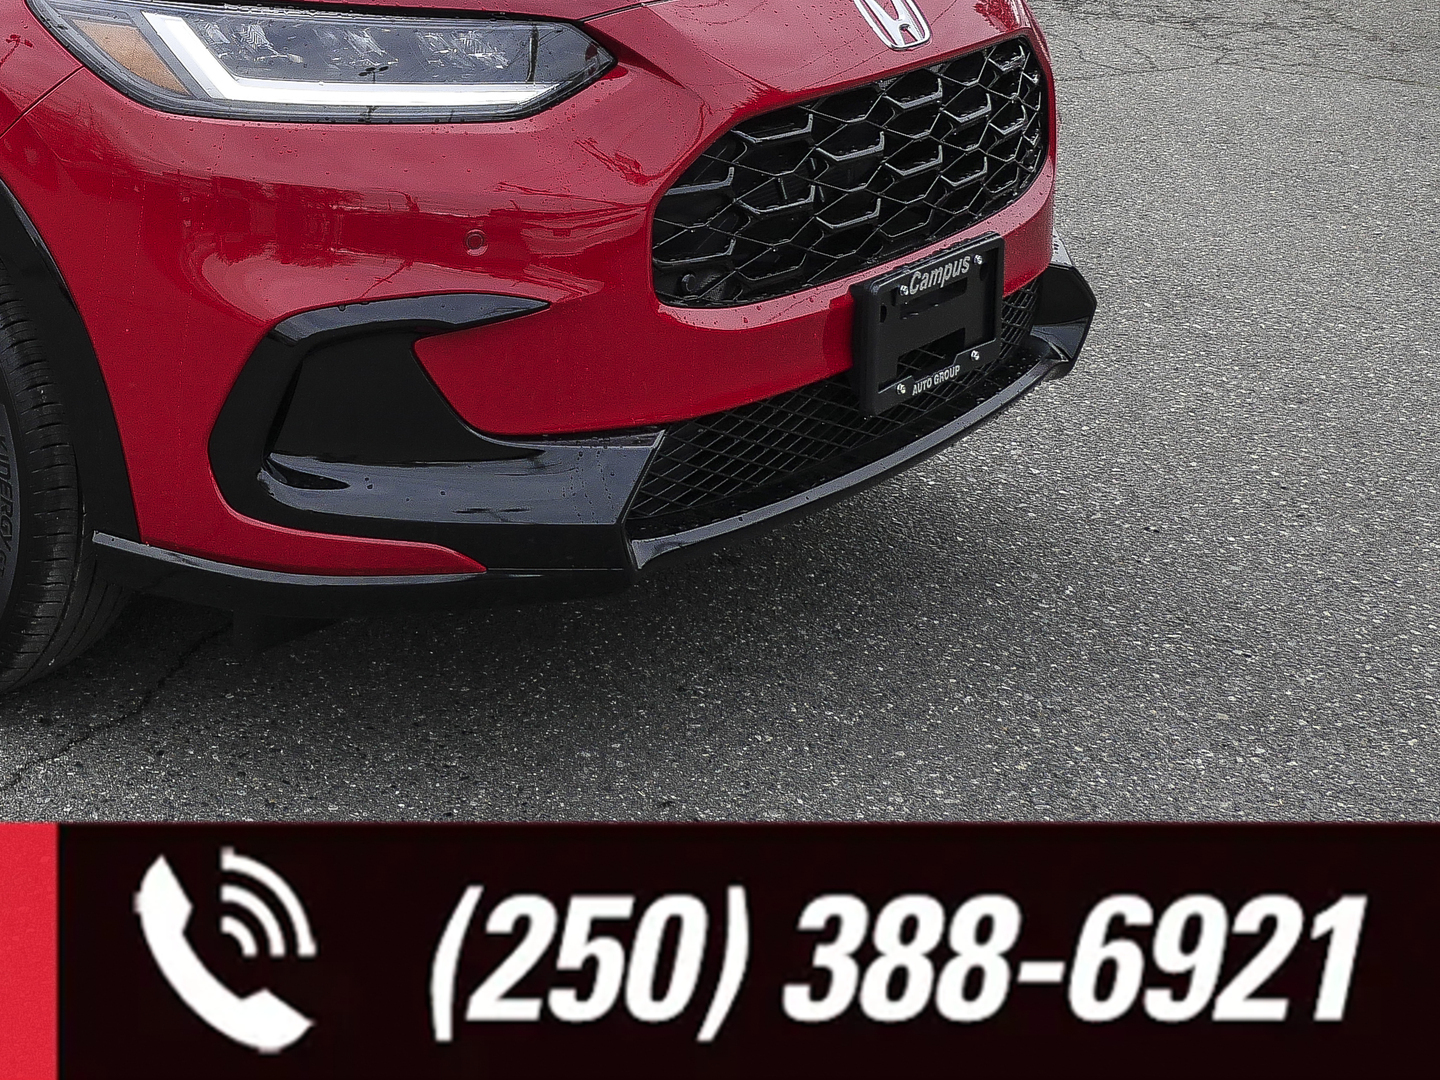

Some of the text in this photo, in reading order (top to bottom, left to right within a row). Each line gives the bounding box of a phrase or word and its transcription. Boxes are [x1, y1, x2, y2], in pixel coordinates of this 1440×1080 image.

[909, 255, 971, 295] Campus
[911, 365, 961, 396] AUTO GROUP
